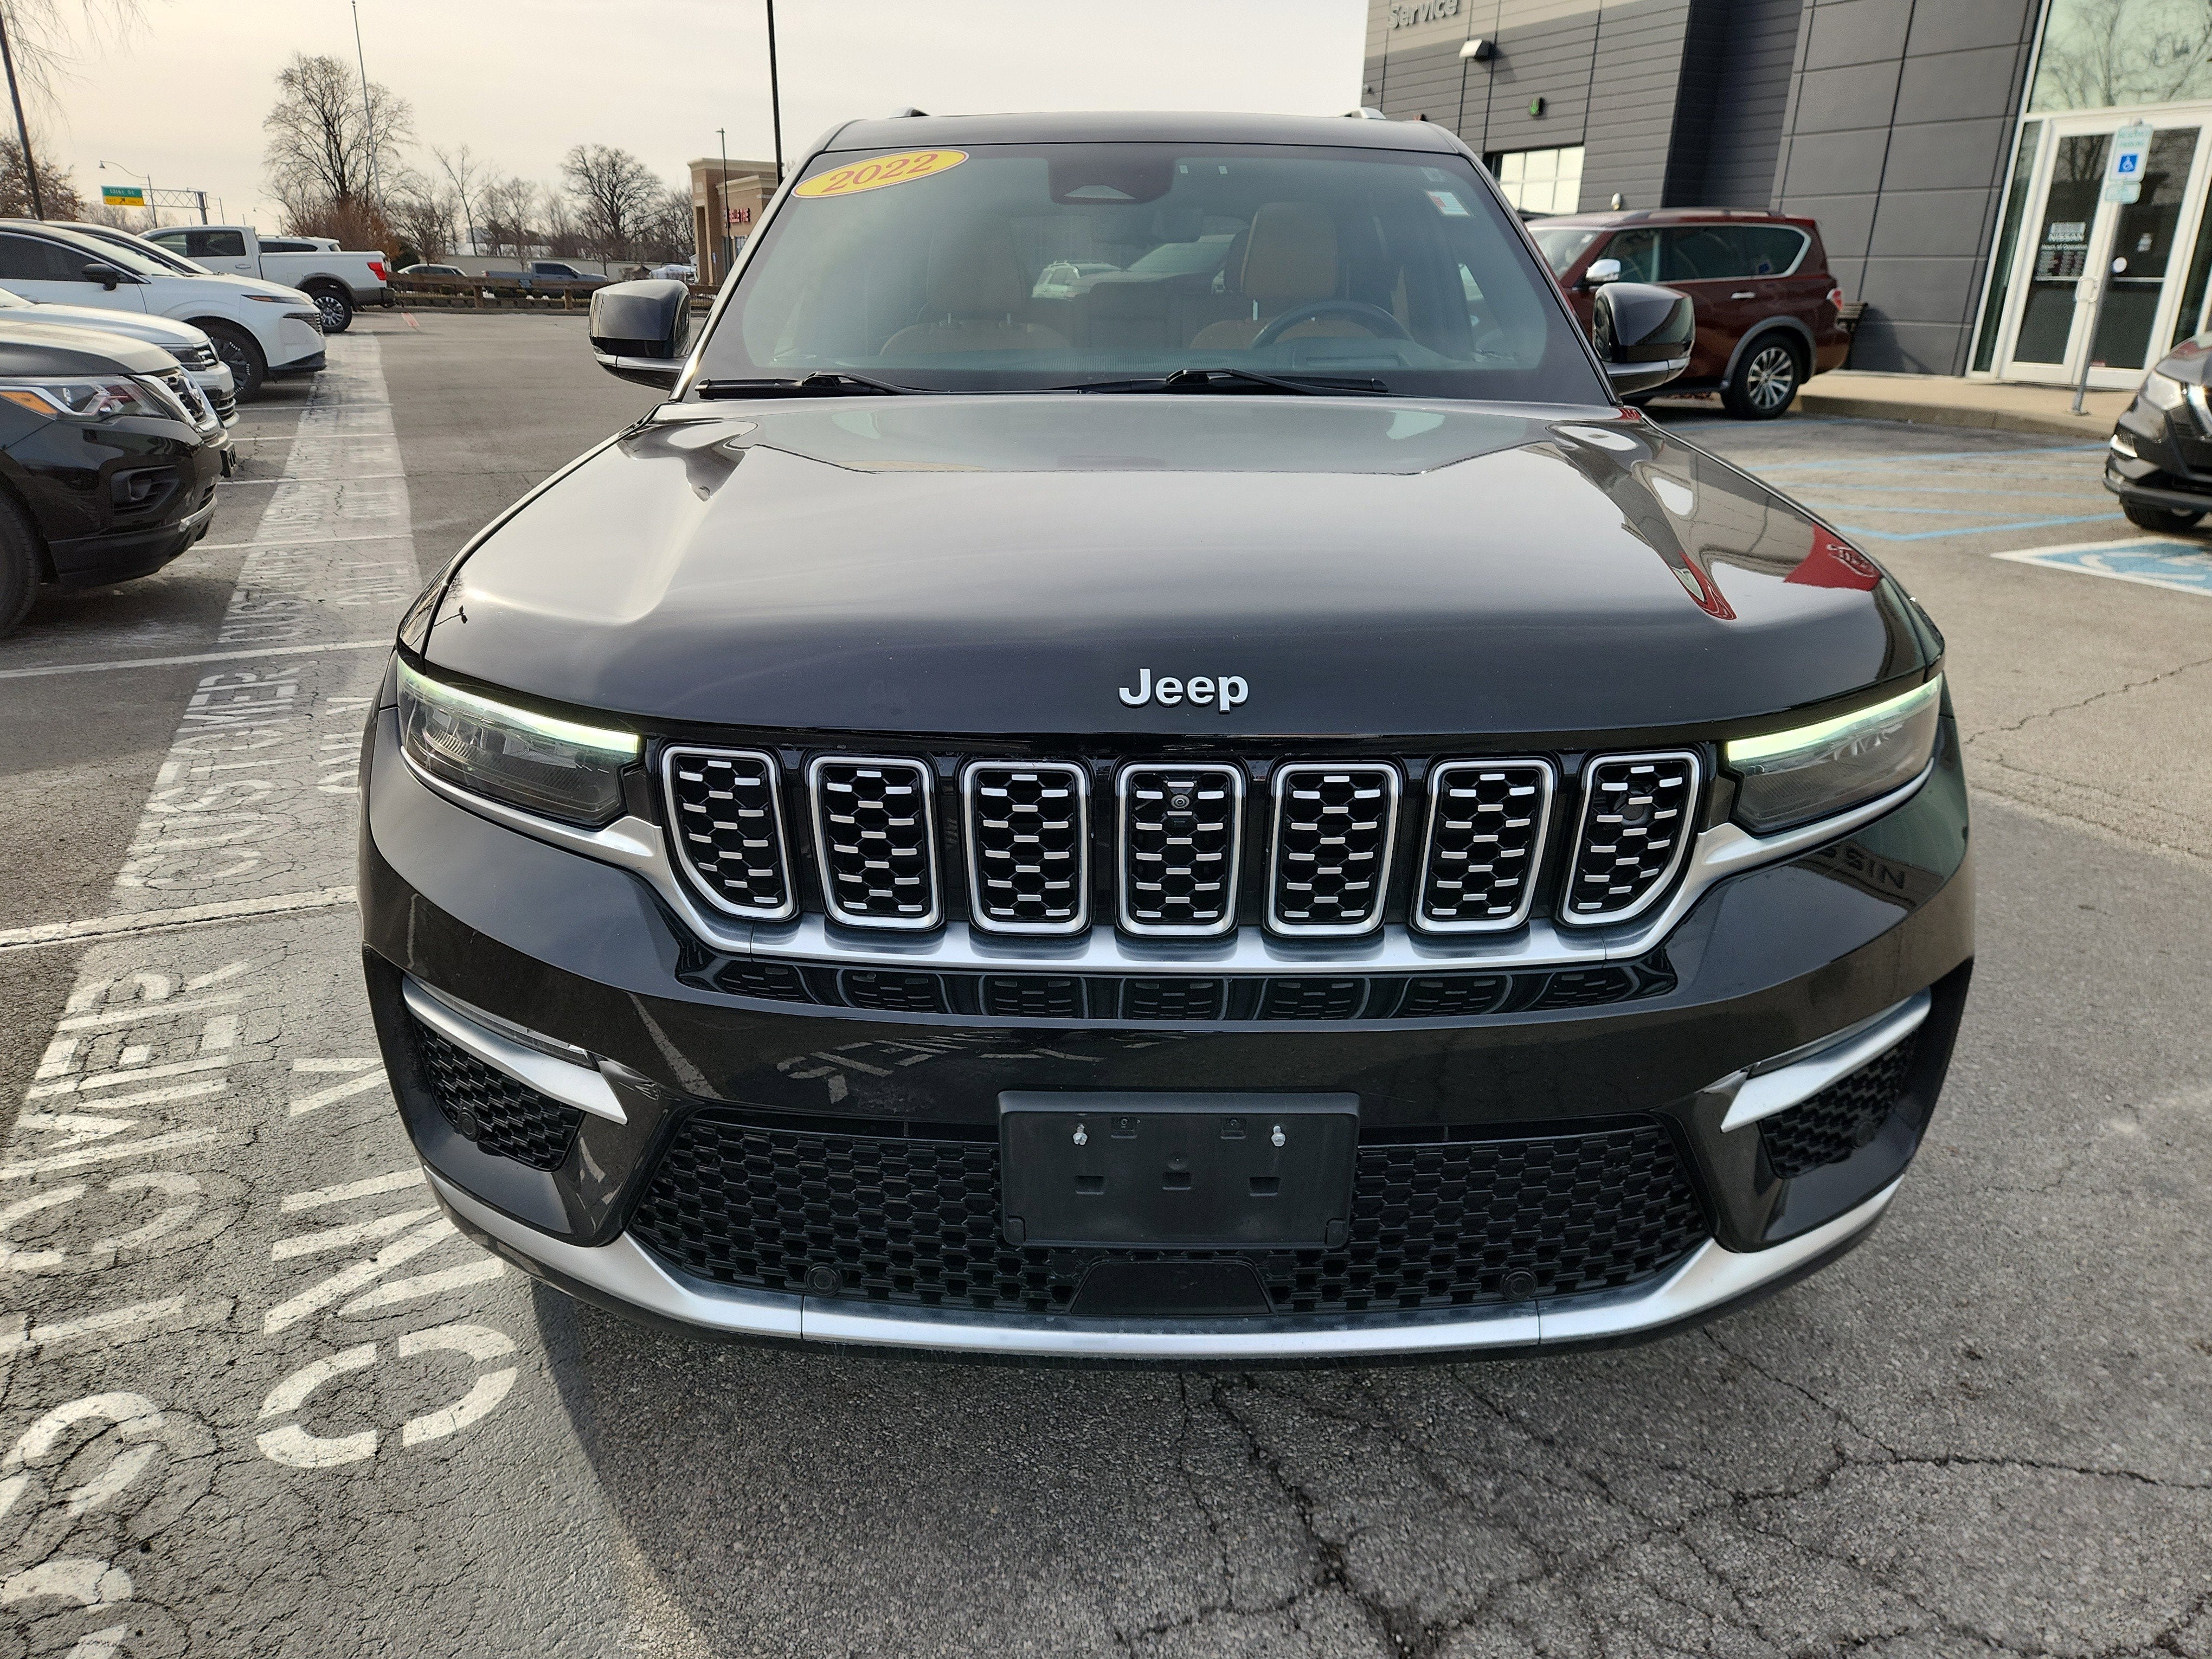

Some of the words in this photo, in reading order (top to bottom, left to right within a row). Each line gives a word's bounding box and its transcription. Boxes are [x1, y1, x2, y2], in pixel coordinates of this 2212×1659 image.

[1387, 0, 1458, 28] Service
[821, 153, 938, 193] 2022
[2048, 234, 2084, 242] NISSAN
[1118, 668, 1249, 712] Jeep
